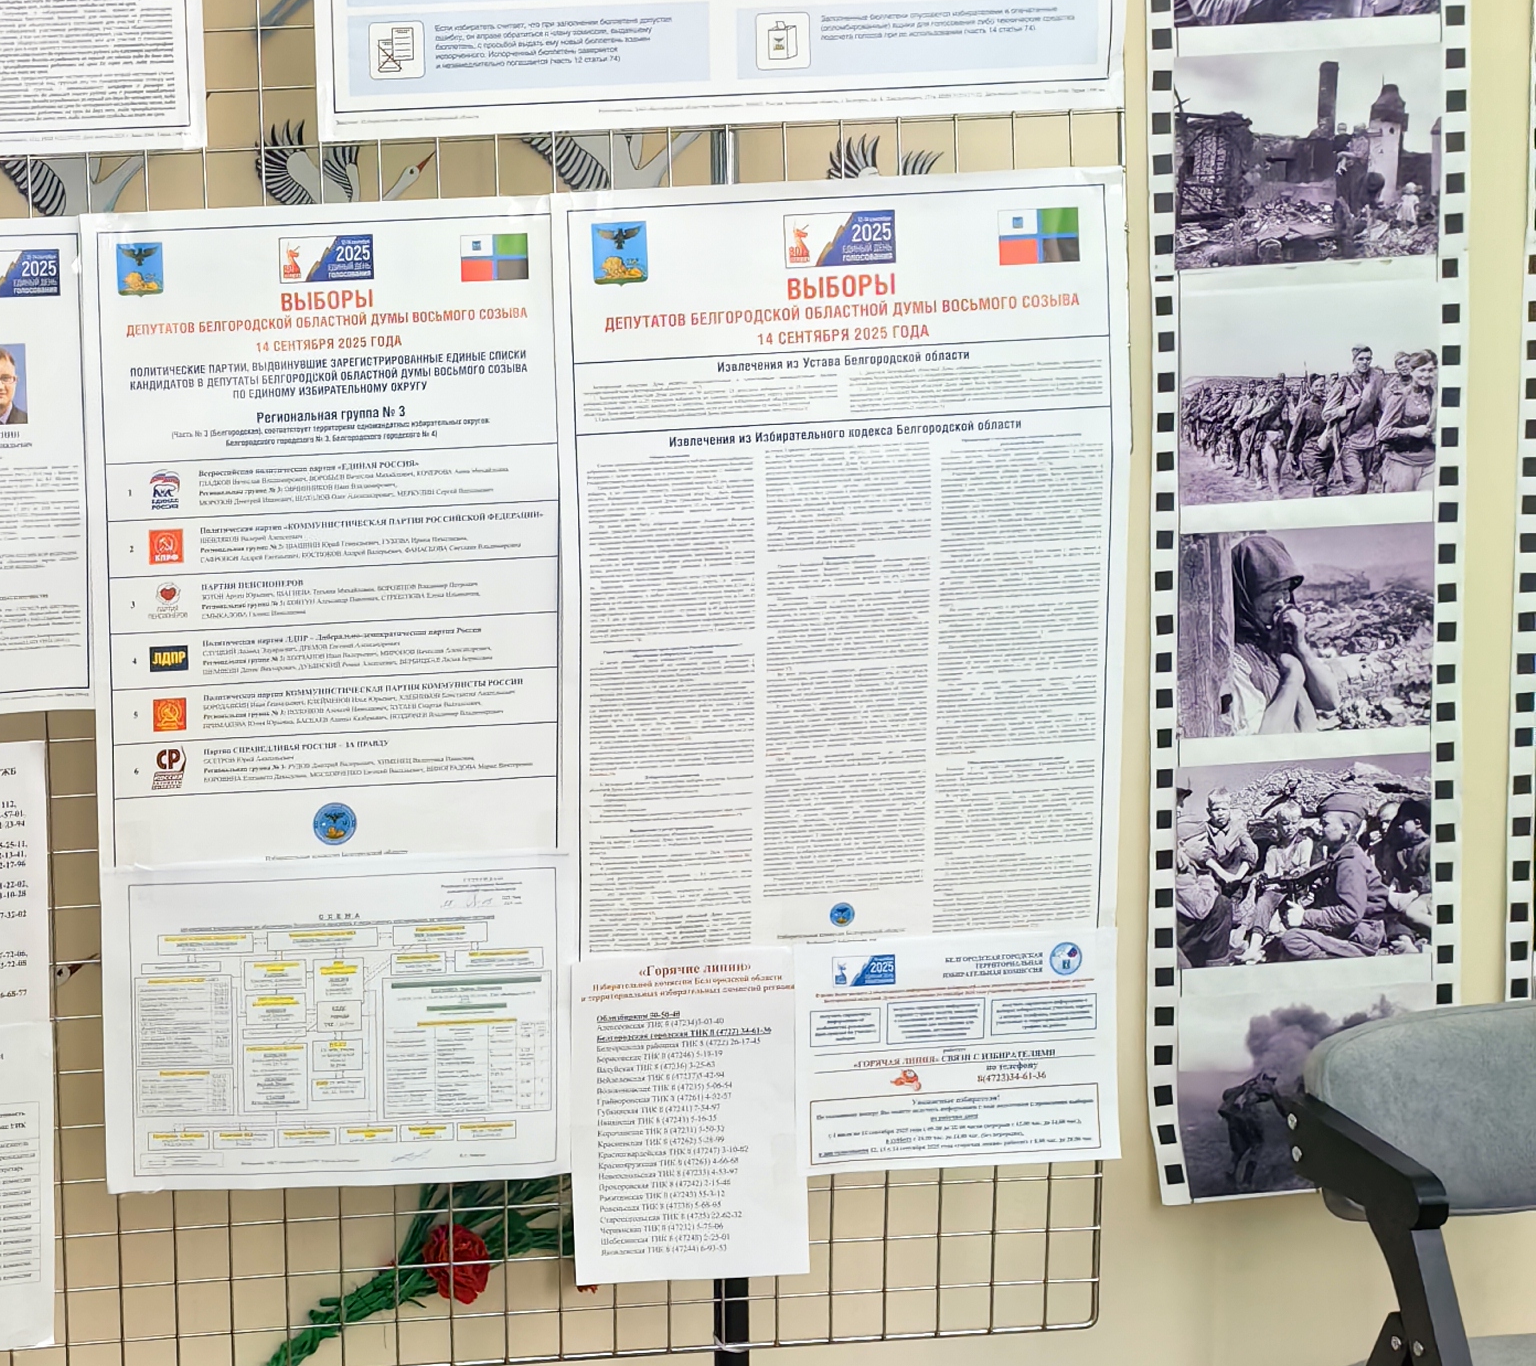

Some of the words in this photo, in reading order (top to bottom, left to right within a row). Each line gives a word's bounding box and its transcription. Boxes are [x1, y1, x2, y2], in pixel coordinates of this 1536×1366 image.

[852, 223, 891, 242] 2025
[336, 245, 370, 261] 2025
[22, 260, 56, 277] 2025
[788, 273, 895, 300] ВЫБОРЫ
[281, 289, 373, 311] ВЫБОРЫ
[127, 322, 194, 337] ДЕПУТАТОВ
[199, 316, 291, 332] БЕЛГОРОДСКОЙ
[296, 313, 366, 328] ОБЛАСТНОЙ
[371, 312, 408, 326] ДУМЫ
[413, 310, 475, 322] ВОСЬМОГО
[480, 307, 527, 320] СОЗЫВА
[605, 313, 685, 332] ДЕПУТАТОВ
[691, 306, 799, 325] БЕЛГОРОДСКОЙ
[805, 302, 887, 319] ОБЛАСТНОЙ
[893, 300, 936, 317] ДУМЫ
[942, 296, 1016, 312] ВОСЬМОГО
[1023, 293, 1079, 308] СОЗЫВА
[257, 342, 269, 352] 14
[274, 339, 333, 351] СЕНТЯБРЯ
[338, 337, 366, 348] 2025
[371, 335, 402, 348] ГОДА
[758, 333, 773, 345] 14
[779, 329, 849, 344] СЕНТЯБРЯ
[855, 327, 887, 340] 2025
[893, 324, 929, 340] ГОДА
[130, 365, 205, 377] ПОЛИТИЧЕСКИЕ
[253, 359, 327, 372] ВЫДВИНУВШИЕ
[331, 354, 443, 367] ЗАРЕГИСТРИРОВАННЫЕ
[447, 352, 485, 363] ЕДИНЫЕ
[490, 350, 526, 360] СПИСКИ
[718, 361, 782, 372] Извлечения
[787, 361, 798, 369] из
[803, 358, 840, 368] Устава
[845, 352, 921, 366] Белгородской
[926, 351, 969, 361] области
[130, 379, 194, 391] КАНДИДАТОВ
[198, 378, 203, 387] В
[207, 376, 258, 388] ДЕПУТАТЫ
[262, 370, 337, 384] БЕЛГОРОДСКОЙ
[341, 368, 397, 381] ОБЛАСТНОЙ
[401, 368, 430, 379] ДУМЫ
[434, 365, 484, 376] ВОСЬМОГО
[488, 364, 527, 373] СОЗЫВА
[234, 390, 245, 398] ПО
[249, 387, 295, 399] ЕДИНОМУ
[299, 383, 387, 395] ИЗБИРАТЕЛЬНОМУ
[391, 381, 427, 392] ОКРУГУ
[257, 411, 337, 423] Региональная
[341, 409, 379, 421] группа
[383, 406, 395, 417] №
[399, 406, 405, 416] 3
[670, 436, 735, 447] Извлечения
[739, 435, 751, 443] из
[756, 430, 844, 443] Избирательного
[849, 427, 892, 438] кодекса
[897, 421, 974, 435] Белгородской
[978, 420, 1021, 430] области
[152, 650, 186, 666] ЛДПР
[870, 962, 894, 973] 2025
